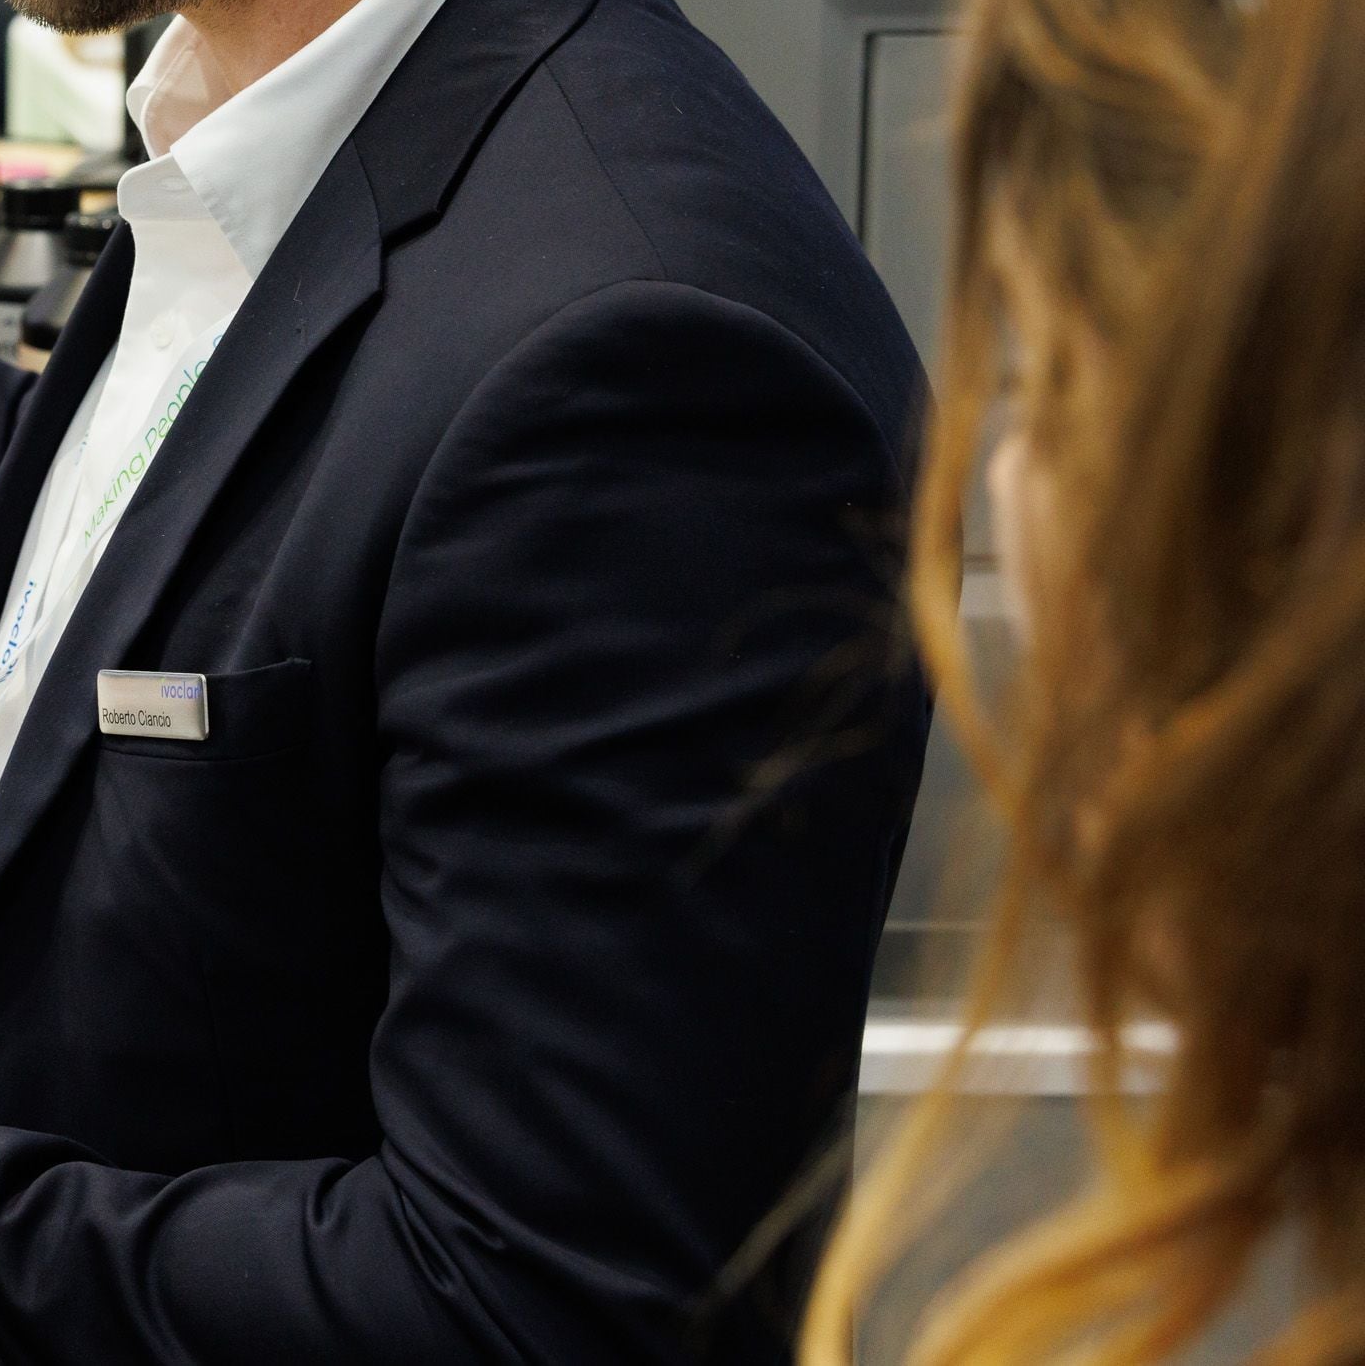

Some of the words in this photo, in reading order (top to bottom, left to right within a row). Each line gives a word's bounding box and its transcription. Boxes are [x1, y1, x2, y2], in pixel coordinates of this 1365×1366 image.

[83, 451, 146, 548] Making
[160, 678, 200, 699] ivoclar
[102, 708, 136, 725] Roberto
[138, 710, 171, 727] Ciancio
